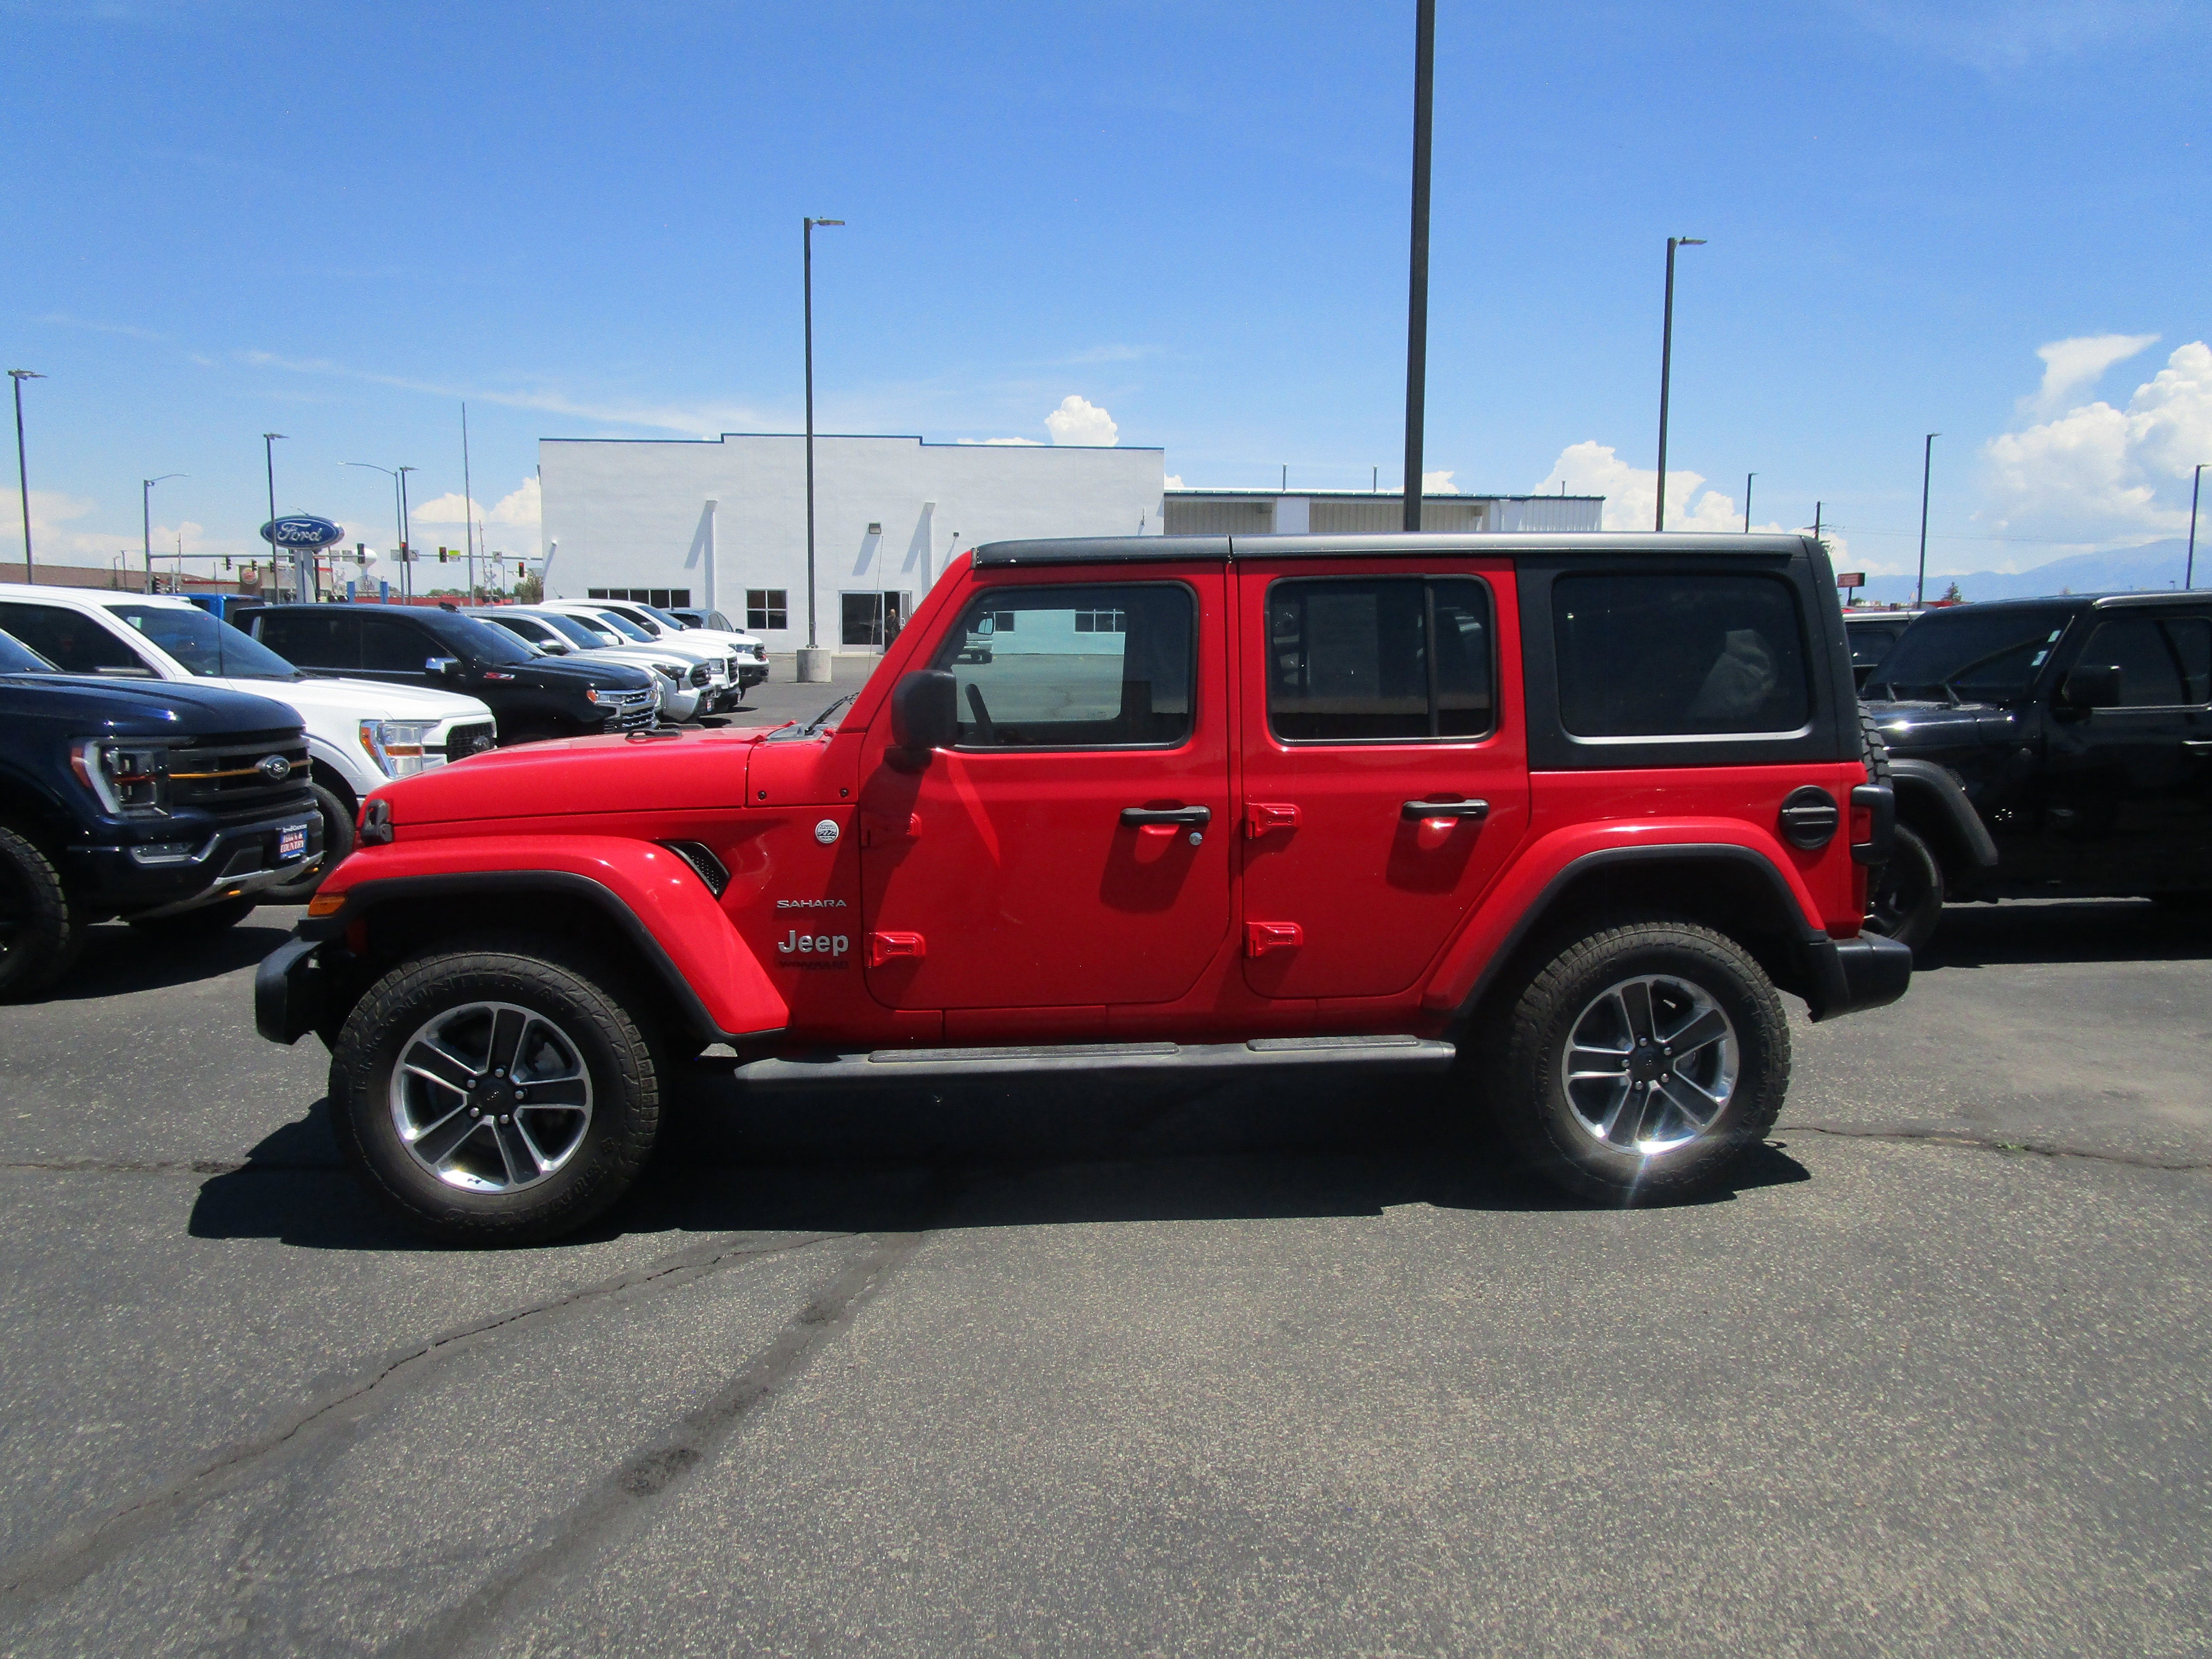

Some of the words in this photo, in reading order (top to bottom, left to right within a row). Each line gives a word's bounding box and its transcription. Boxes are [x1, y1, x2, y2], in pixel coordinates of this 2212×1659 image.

[277, 522, 322, 541] Ford
[280, 839, 304, 853] COUNTRY
[776, 899, 847, 908] SAHARA
[778, 930, 849, 957] Jeep
